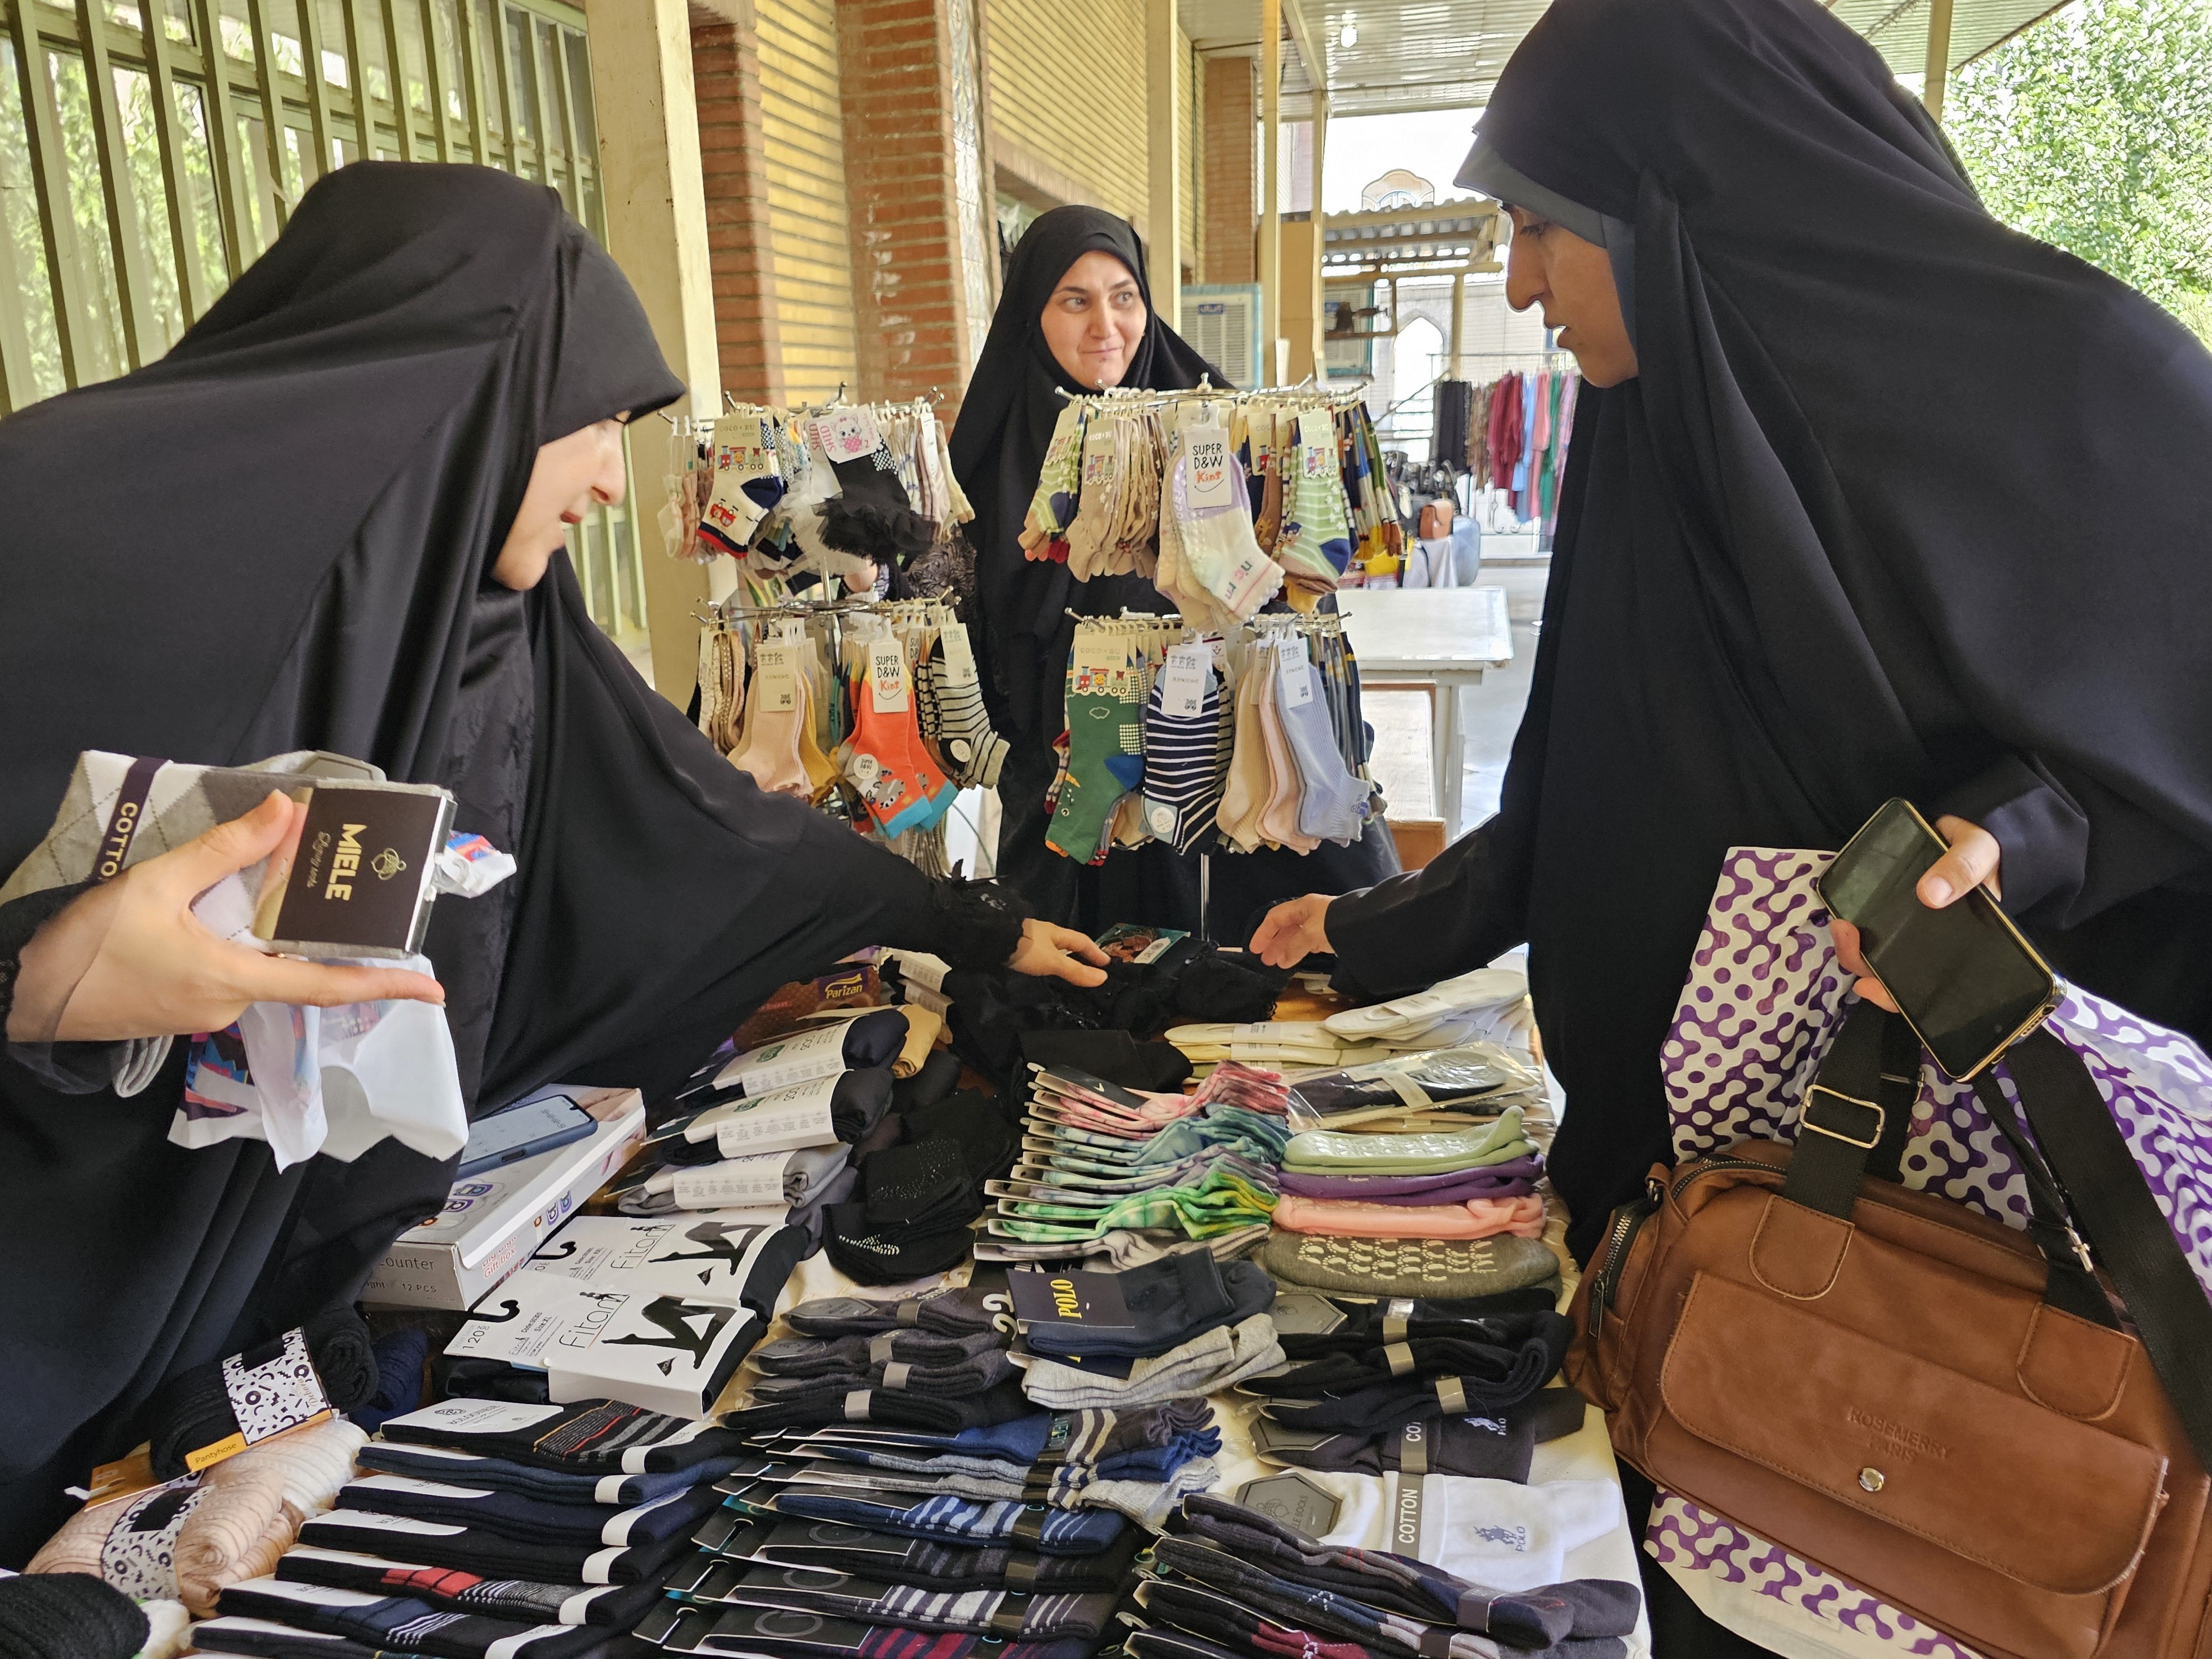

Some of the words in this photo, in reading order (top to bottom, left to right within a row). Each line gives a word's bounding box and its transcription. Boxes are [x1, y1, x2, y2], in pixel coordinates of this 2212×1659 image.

[1193, 443, 1222, 456] SUPER
[1194, 455, 1223, 469] D&W
[875, 655, 899, 666] SUPER
[877, 666, 900, 679] D&W
[100, 802, 138, 878] COTTO
[325, 824, 367, 900] MIELE
[826, 984, 863, 999] Parizan
[500, 1248, 515, 1264] box
[402, 1283, 413, 1291] 12
[417, 1285, 437, 1293] PCS
[1050, 1279, 1079, 1318] POLO
[462, 1330, 485, 1349] 120
[195, 1442, 237, 1464] Pantyhose
[1398, 1488, 1418, 1544] COTTON
[1514, 1525, 1526, 1552] POLO
